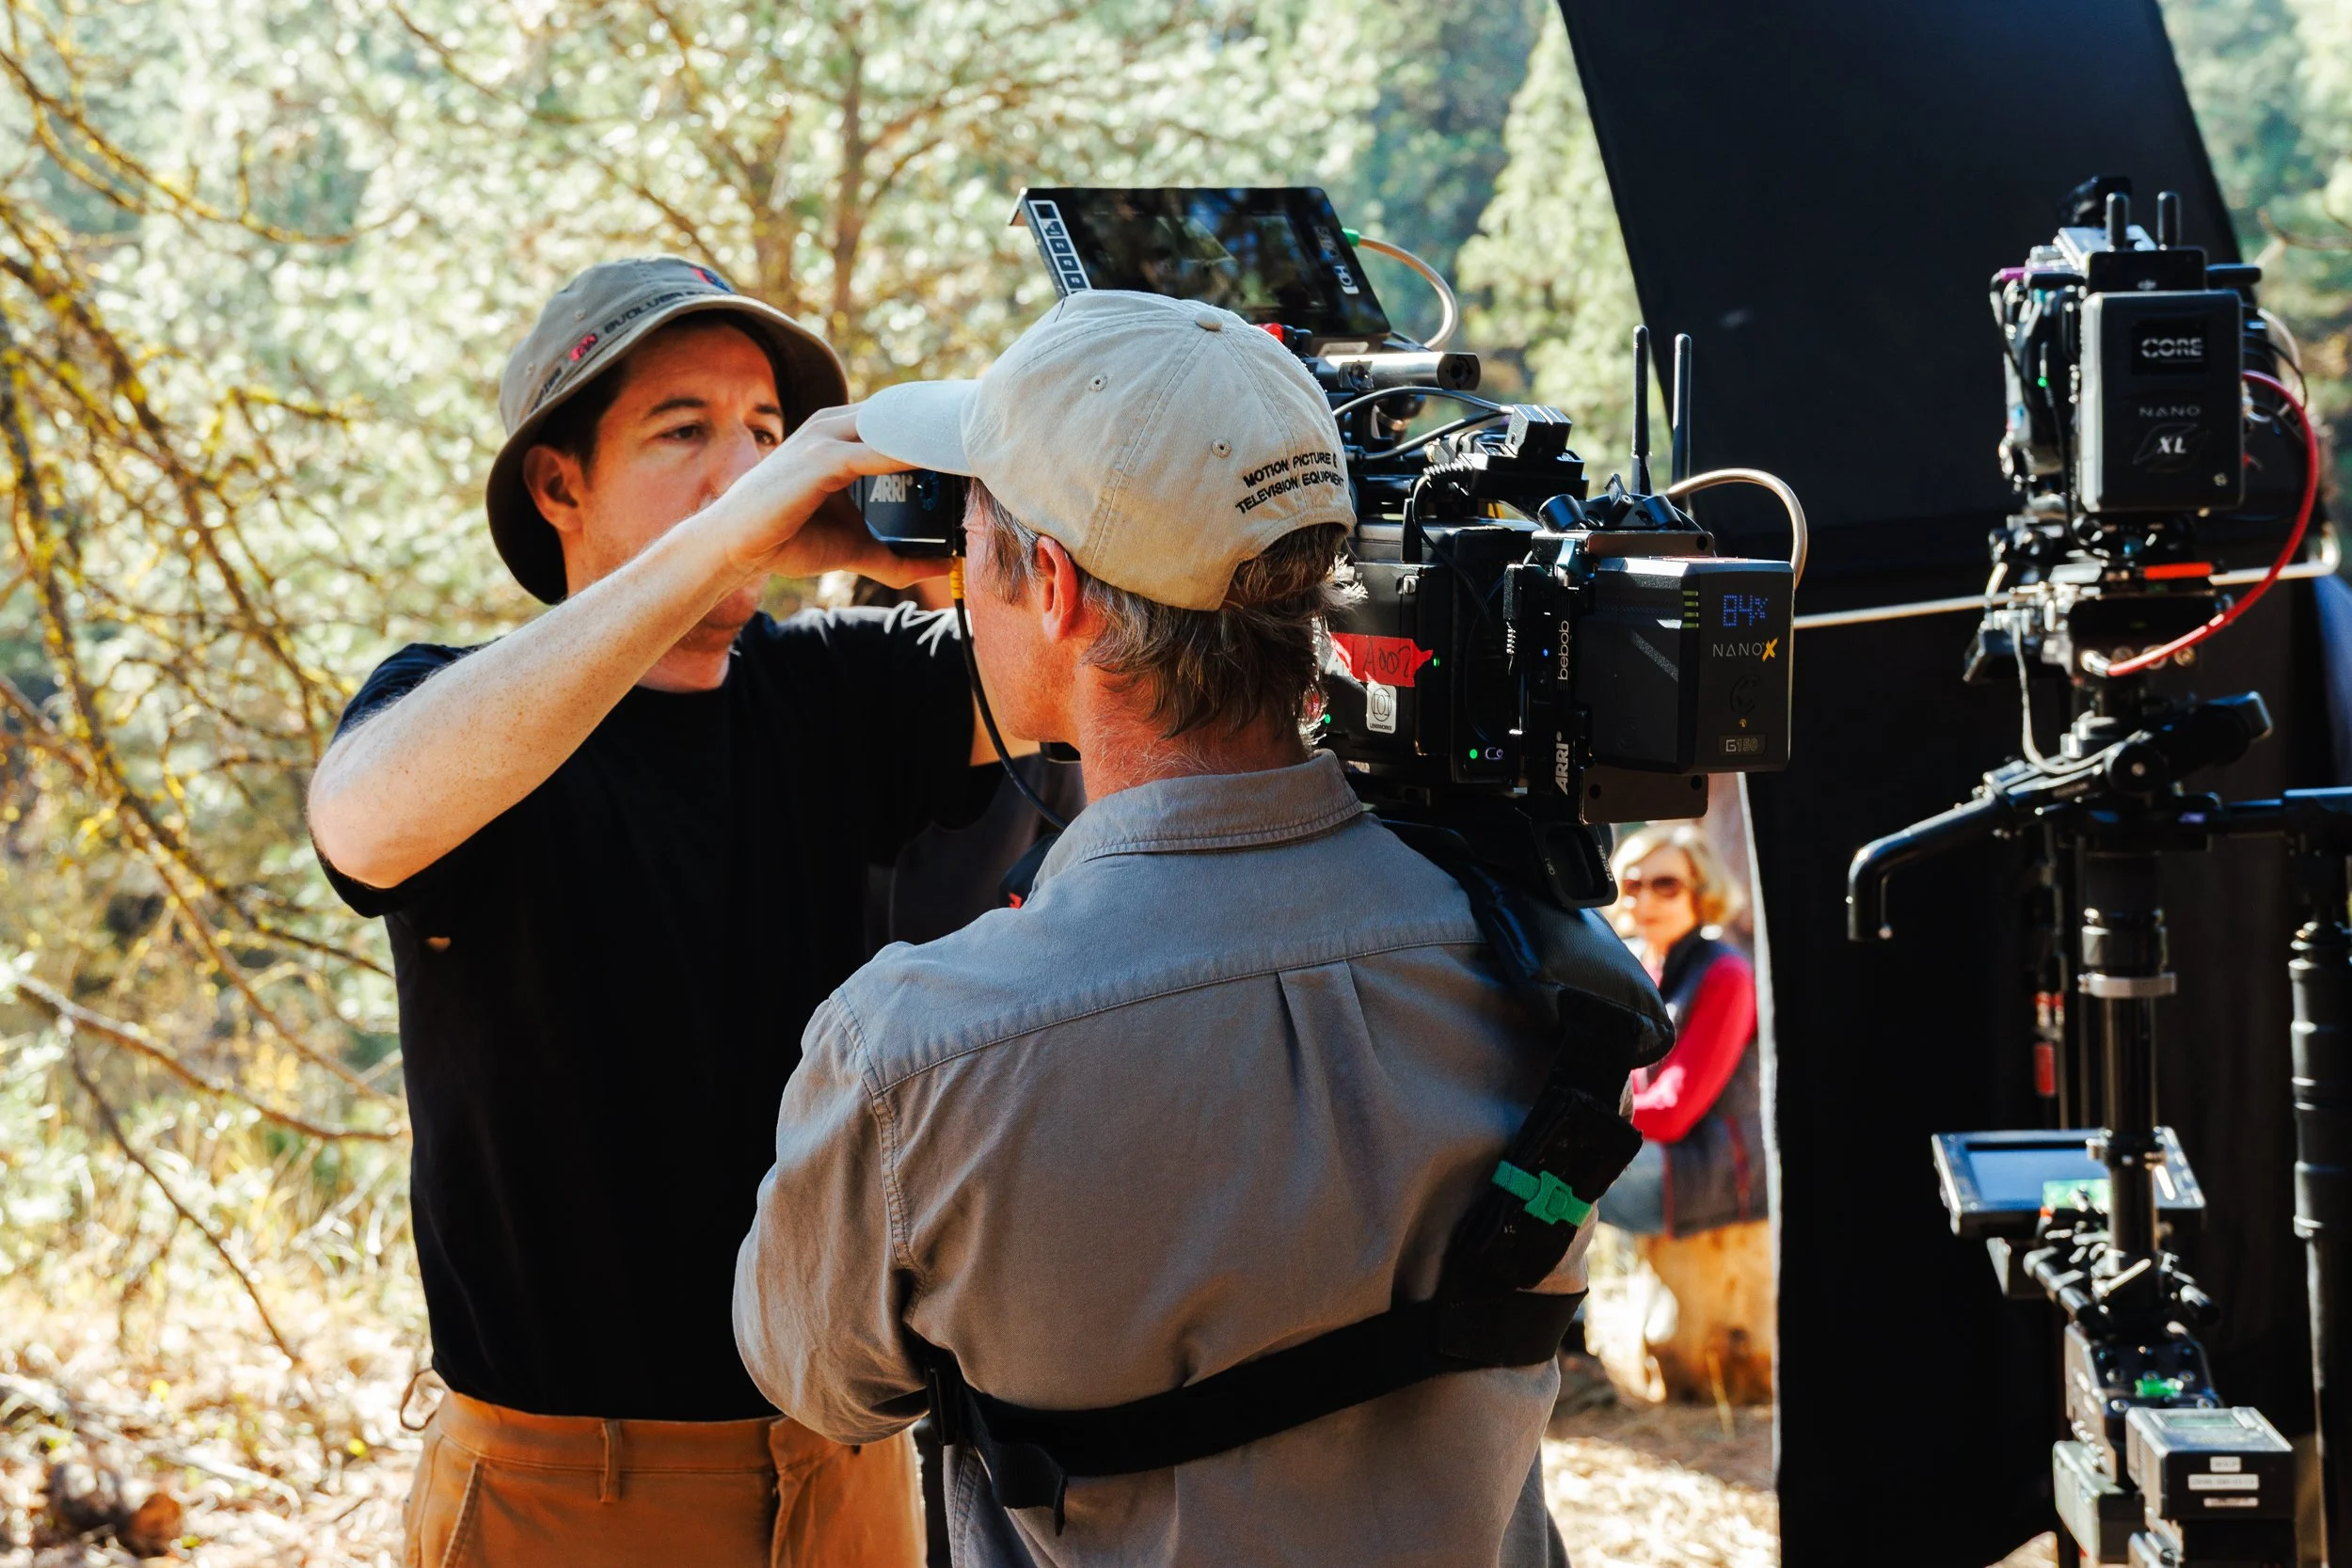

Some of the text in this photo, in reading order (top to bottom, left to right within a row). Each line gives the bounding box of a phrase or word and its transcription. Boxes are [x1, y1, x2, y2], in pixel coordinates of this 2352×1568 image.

[2142, 337, 2203, 358] CORE
[2138, 404, 2202, 418] NANO
[2157, 436, 2187, 454] XL
[1242, 458, 1289, 488] MOTION
[1292, 452, 1331, 468] PICTURE
[869, 475, 907, 502] ARRI
[1235, 473, 1345, 514] TELEVISION EQUIPMENT
[1723, 594, 1769, 627] 84%
[1558, 620, 1569, 681] bebob
[1554, 743, 1569, 796] ARRI
